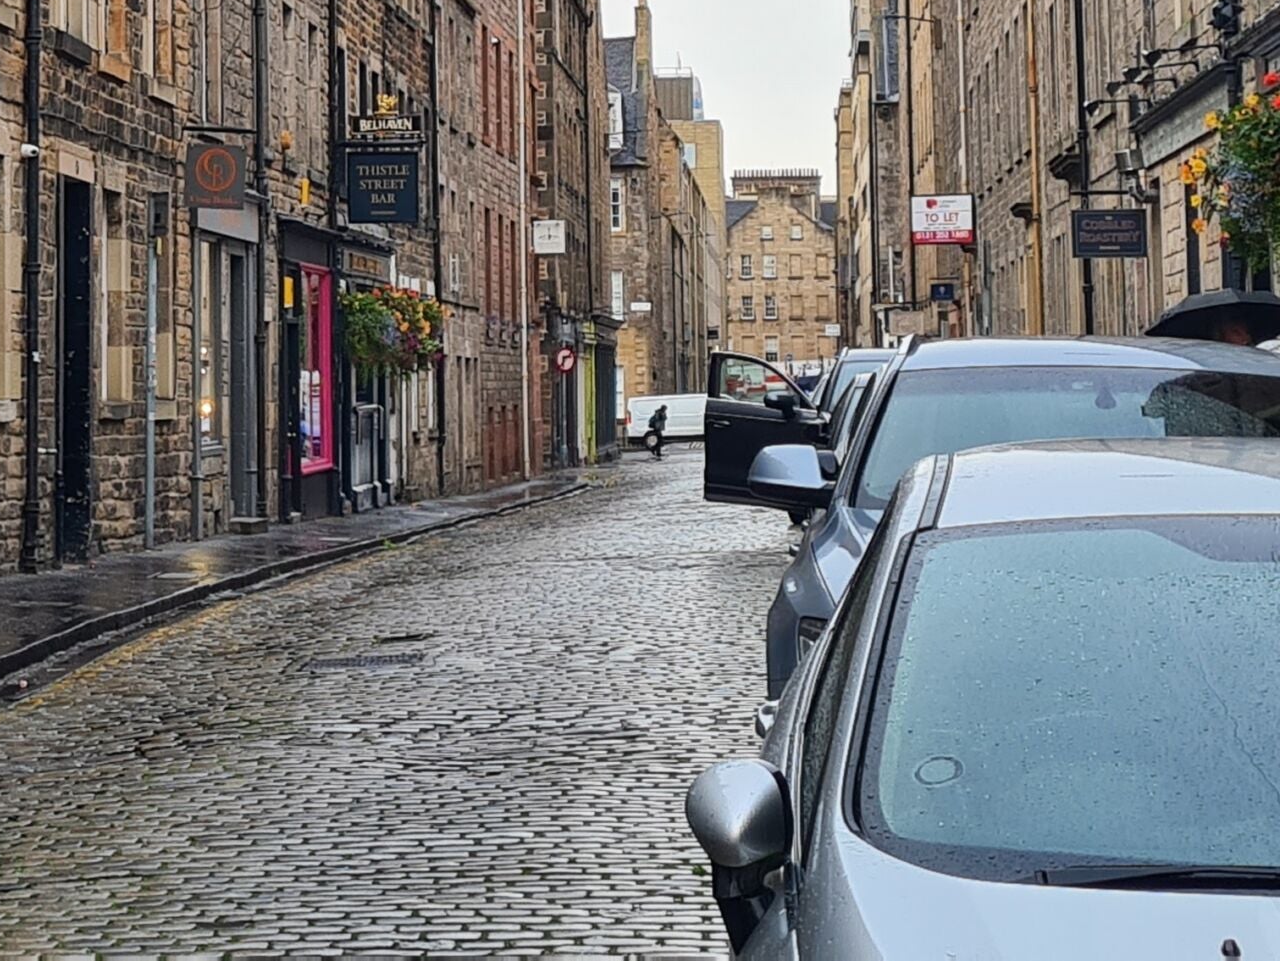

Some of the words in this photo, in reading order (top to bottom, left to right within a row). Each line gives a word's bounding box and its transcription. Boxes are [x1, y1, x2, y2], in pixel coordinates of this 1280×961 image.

[360, 118, 413, 131] BELHAVEN
[356, 165, 410, 176] THISTLE
[359, 179, 406, 190] STREET
[371, 193, 396, 204] BAR
[925, 213, 939, 223] TO
[943, 212, 959, 222] LET
